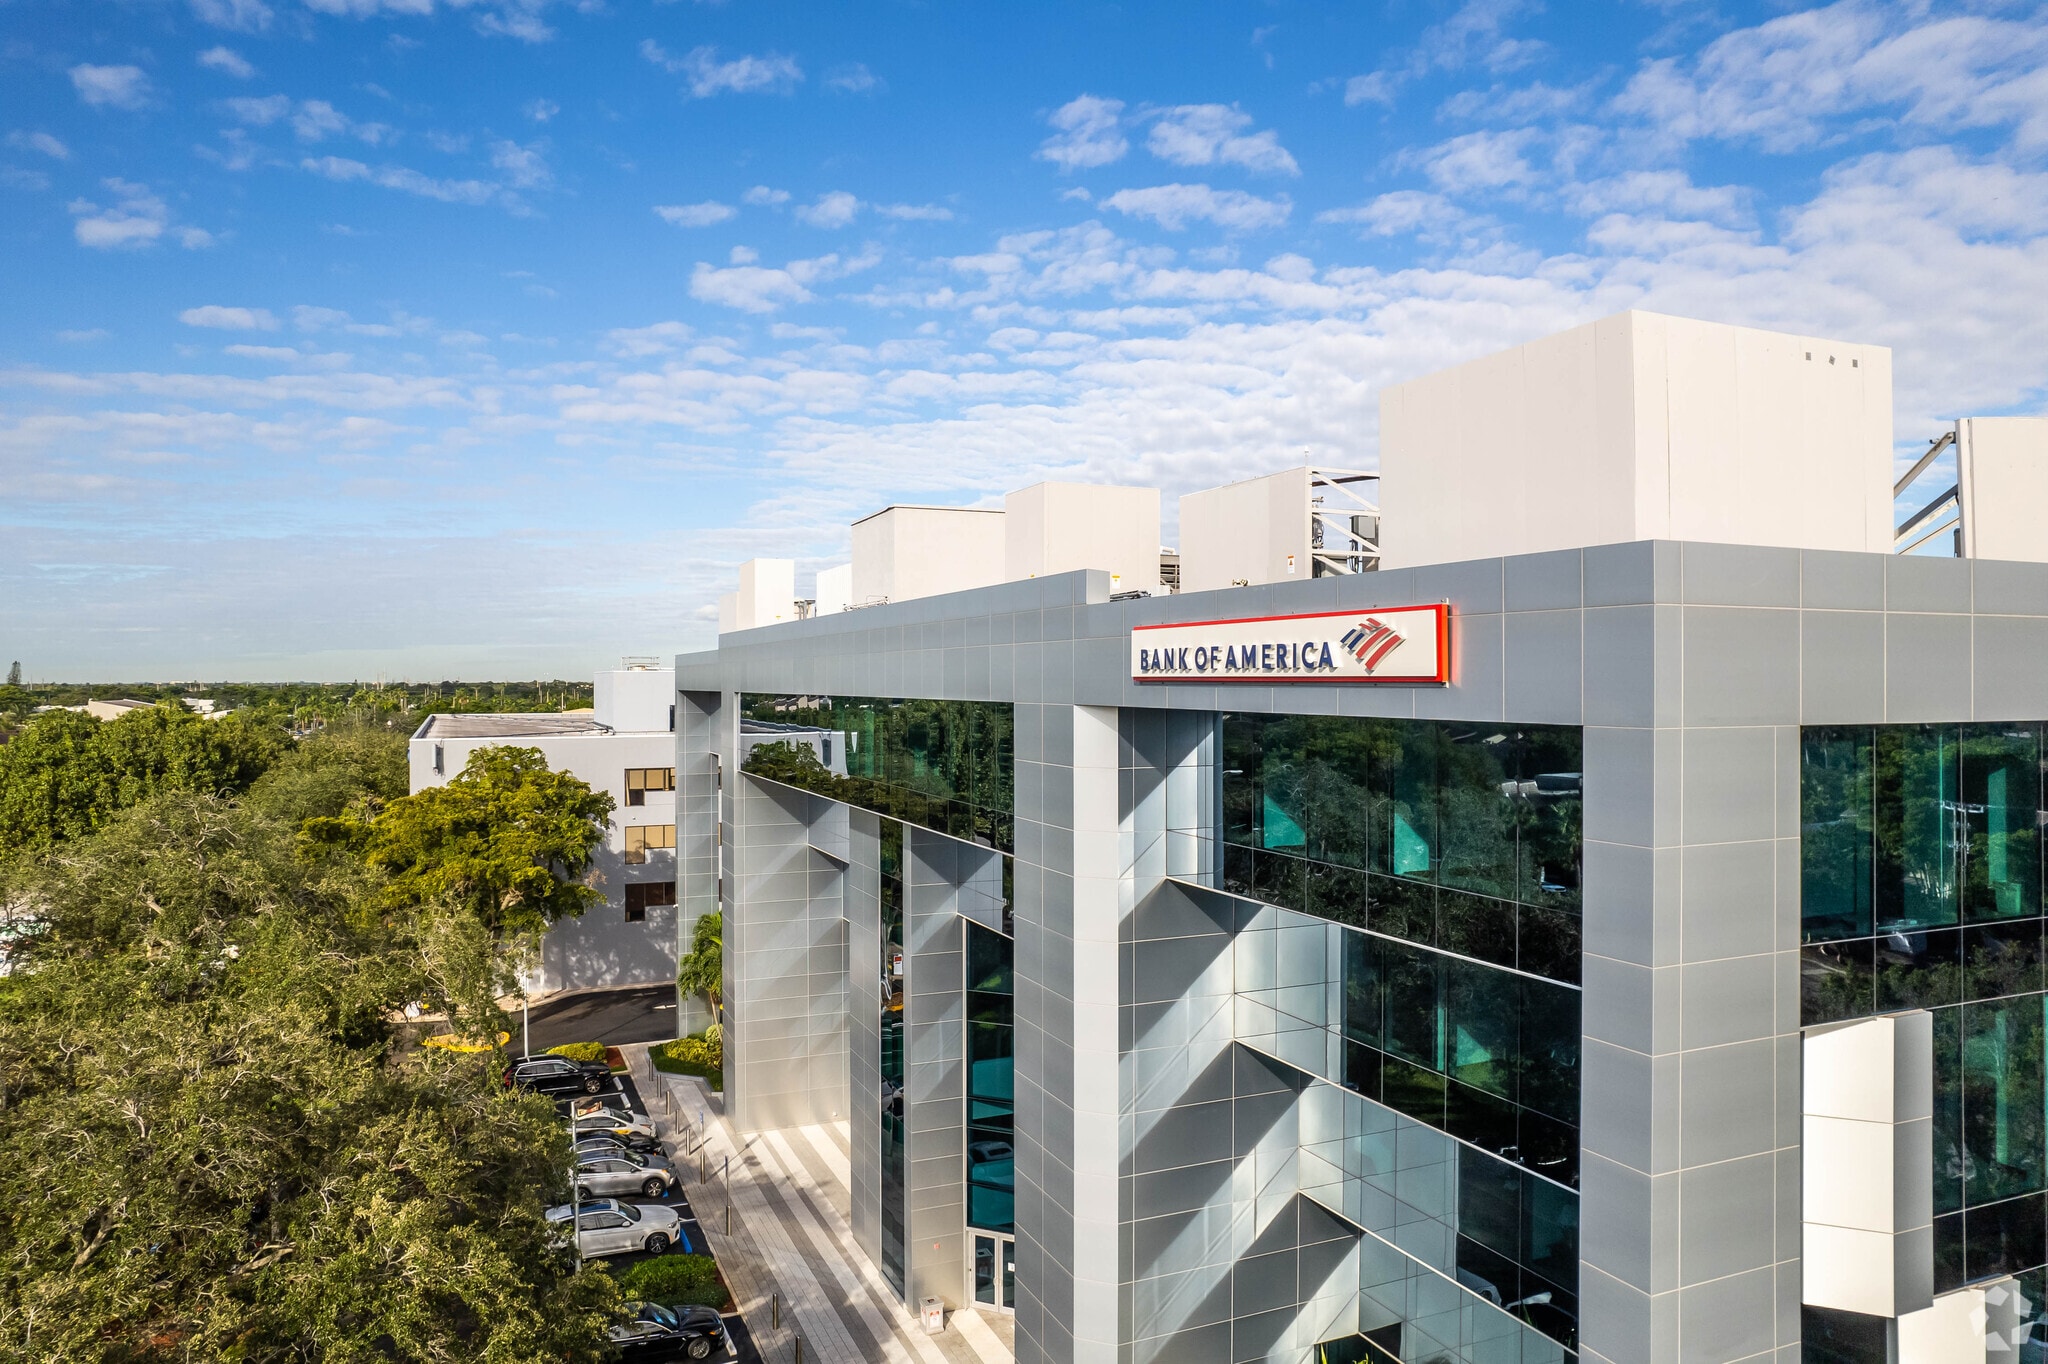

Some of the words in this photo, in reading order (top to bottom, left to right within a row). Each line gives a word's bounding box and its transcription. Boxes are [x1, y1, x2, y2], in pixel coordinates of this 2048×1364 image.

[1140, 648, 1189, 670] BANK
[1195, 646, 1221, 670] OF
[1225, 641, 1334, 669] AMERICA
